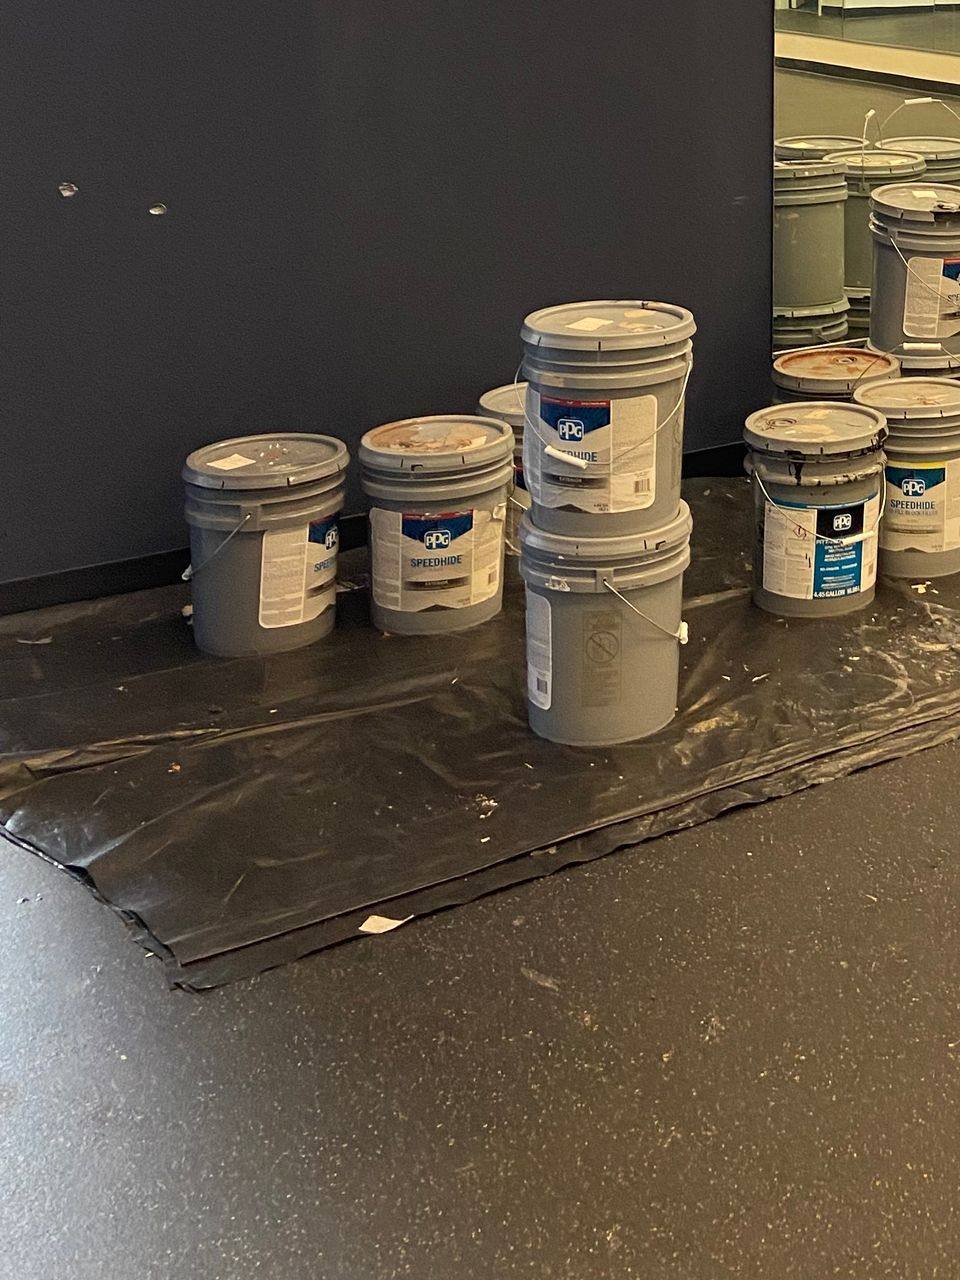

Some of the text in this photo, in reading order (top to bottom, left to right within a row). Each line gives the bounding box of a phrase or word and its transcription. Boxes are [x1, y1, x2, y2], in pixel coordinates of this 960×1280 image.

[558, 420, 583, 440] PPG
[902, 481, 925, 496] PPG
[890, 500, 936, 510] SPEEDHIDE
[833, 515, 851, 530] PPG
[425, 532, 450, 550] PPG
[410, 553, 464, 568] SPEEDHIDE
[825, 589, 846, 597] GALLON
